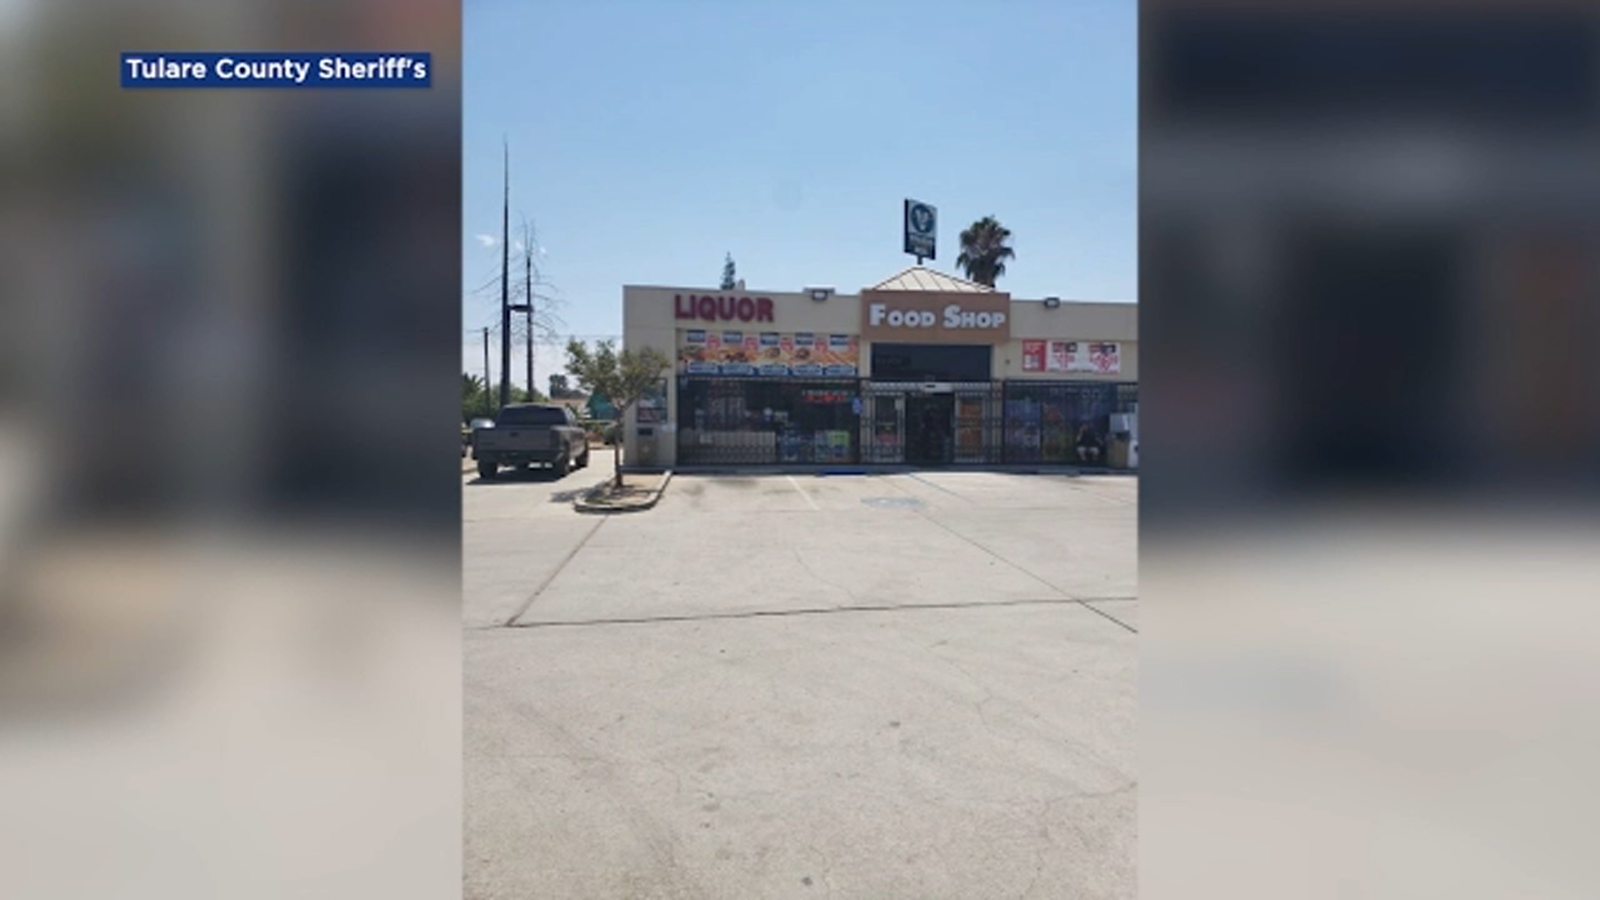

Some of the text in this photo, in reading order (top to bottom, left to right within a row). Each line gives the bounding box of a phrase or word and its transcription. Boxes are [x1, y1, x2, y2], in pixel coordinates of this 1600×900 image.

[674, 294, 775, 323] LIQUOR
[869, 304, 1006, 329] FOOD SHOP
